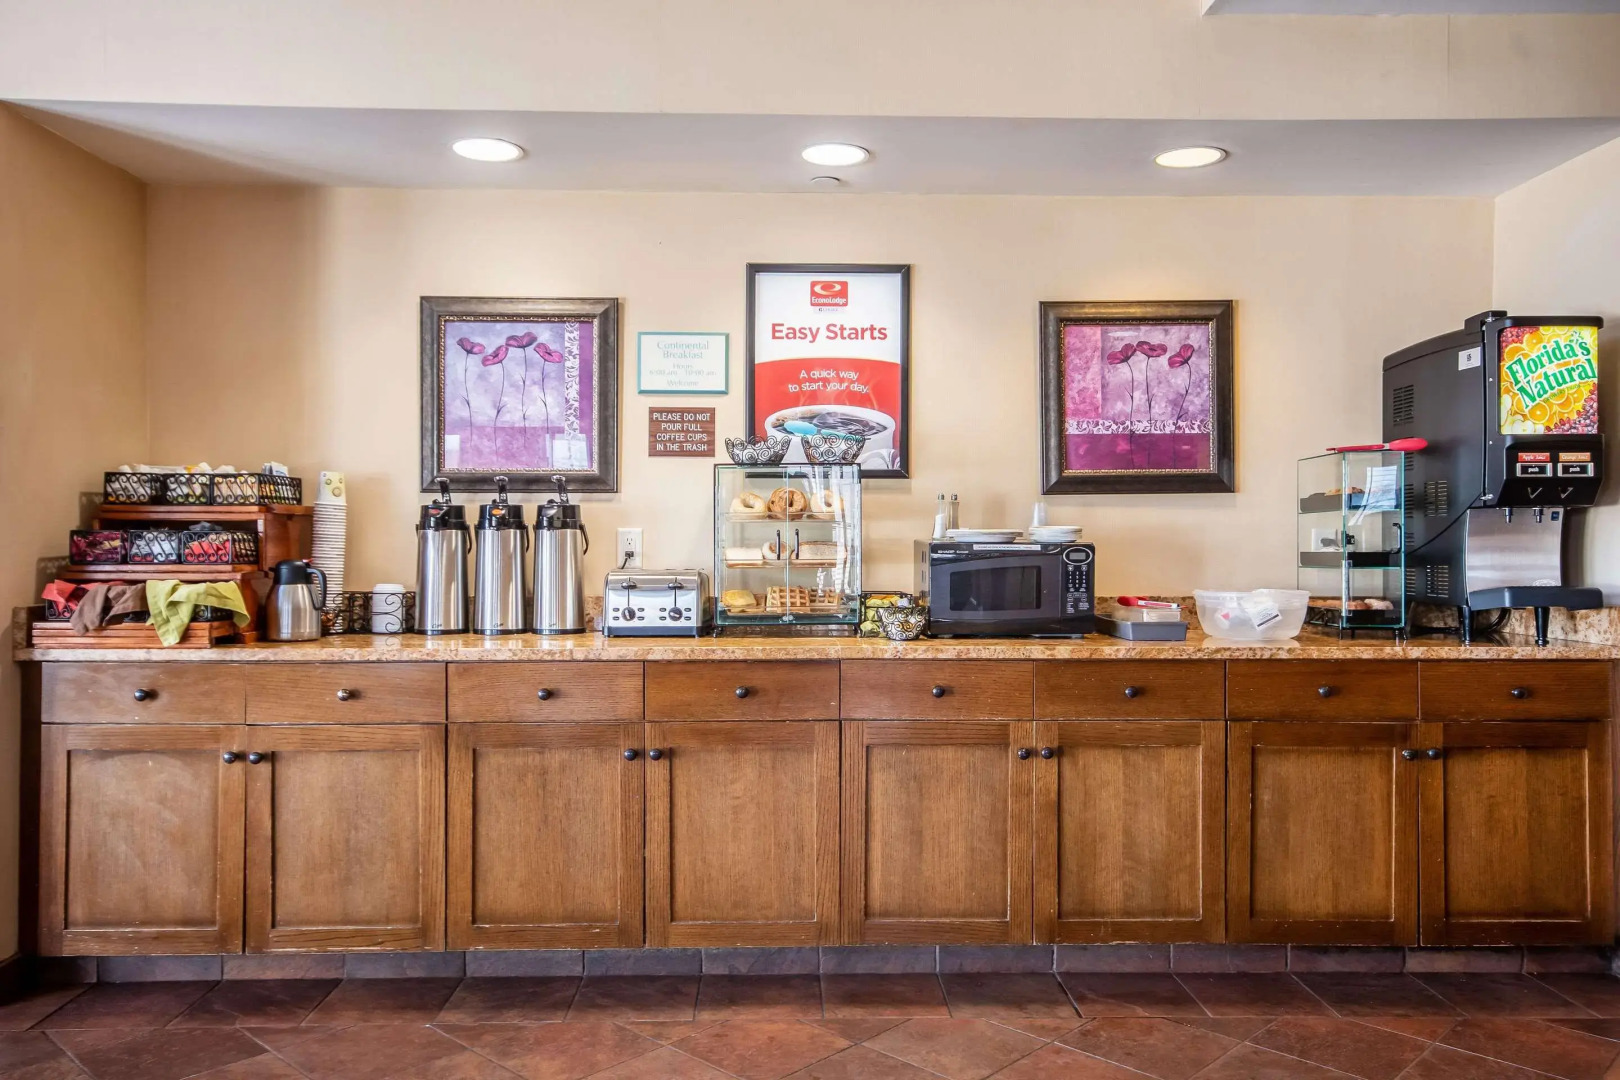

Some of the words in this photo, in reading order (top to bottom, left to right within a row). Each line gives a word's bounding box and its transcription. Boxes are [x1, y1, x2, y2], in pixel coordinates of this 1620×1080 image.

[771, 322, 820, 343] Easy
[825, 323, 888, 340] Starts
[657, 340, 709, 350] Continental
[662, 350, 703, 359] Breakfast
[1505, 338, 1591, 386] Florida's
[799, 370, 808, 379] A
[810, 369, 836, 379] quick
[839, 370, 859, 380] way
[788, 384, 799, 392] to
[801, 381, 823, 391] start
[826, 382, 848, 391] your
[849, 382, 869, 393] day.
[1516, 358, 1598, 409] Natural
[653, 412, 682, 421] PLEASE
[683, 413, 694, 421] DO
[696, 413, 711, 421] NOT
[661, 422, 682, 430] POUR
[683, 423, 703, 431] FULL
[656, 433, 685, 441] COFFEE
[687, 433, 707, 441] CUPS
[656, 443, 664, 451] IN
[666, 443, 680, 451] THE
[682, 443, 707, 451] TRASH
